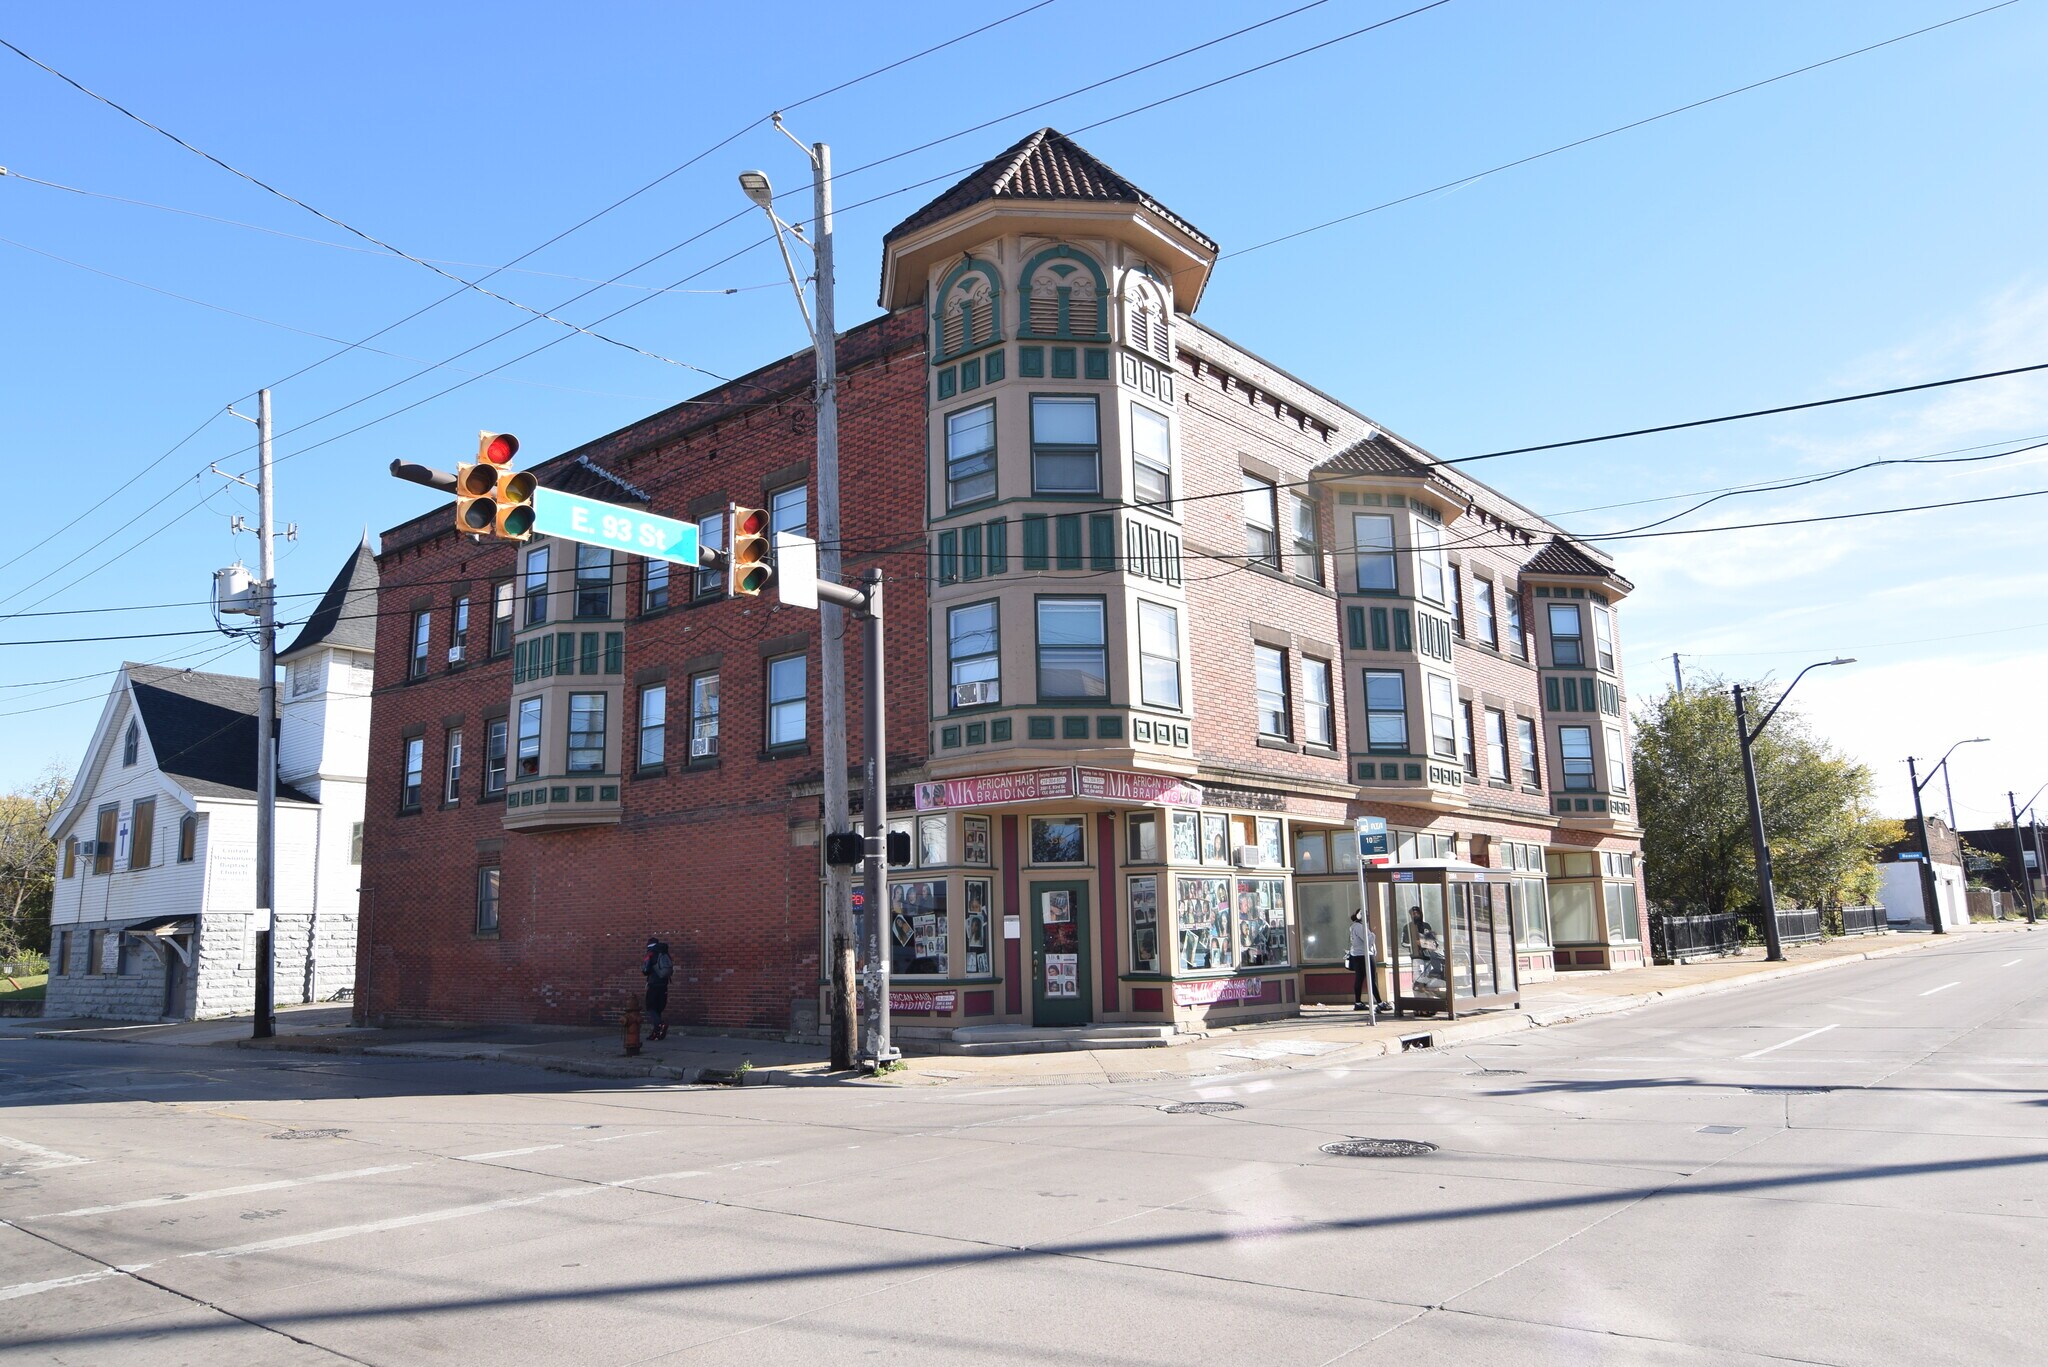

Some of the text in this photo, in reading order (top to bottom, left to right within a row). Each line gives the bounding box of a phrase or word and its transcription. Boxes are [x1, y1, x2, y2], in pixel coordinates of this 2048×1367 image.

[571, 505, 666, 551] E. 93 St
[977, 773, 1035, 791] AFRICAN HAIR
[1109, 772, 1131, 797] MK
[1133, 776, 1160, 788] AFRICAN
[948, 781, 976, 805] MK
[977, 786, 1036, 802] BRAIDING
[1133, 787, 1178, 801] BRAIDING
[1365, 836, 1373, 844] 10
[888, 992, 913, 1001] FRICAN
[913, 992, 932, 1001] HAIR
